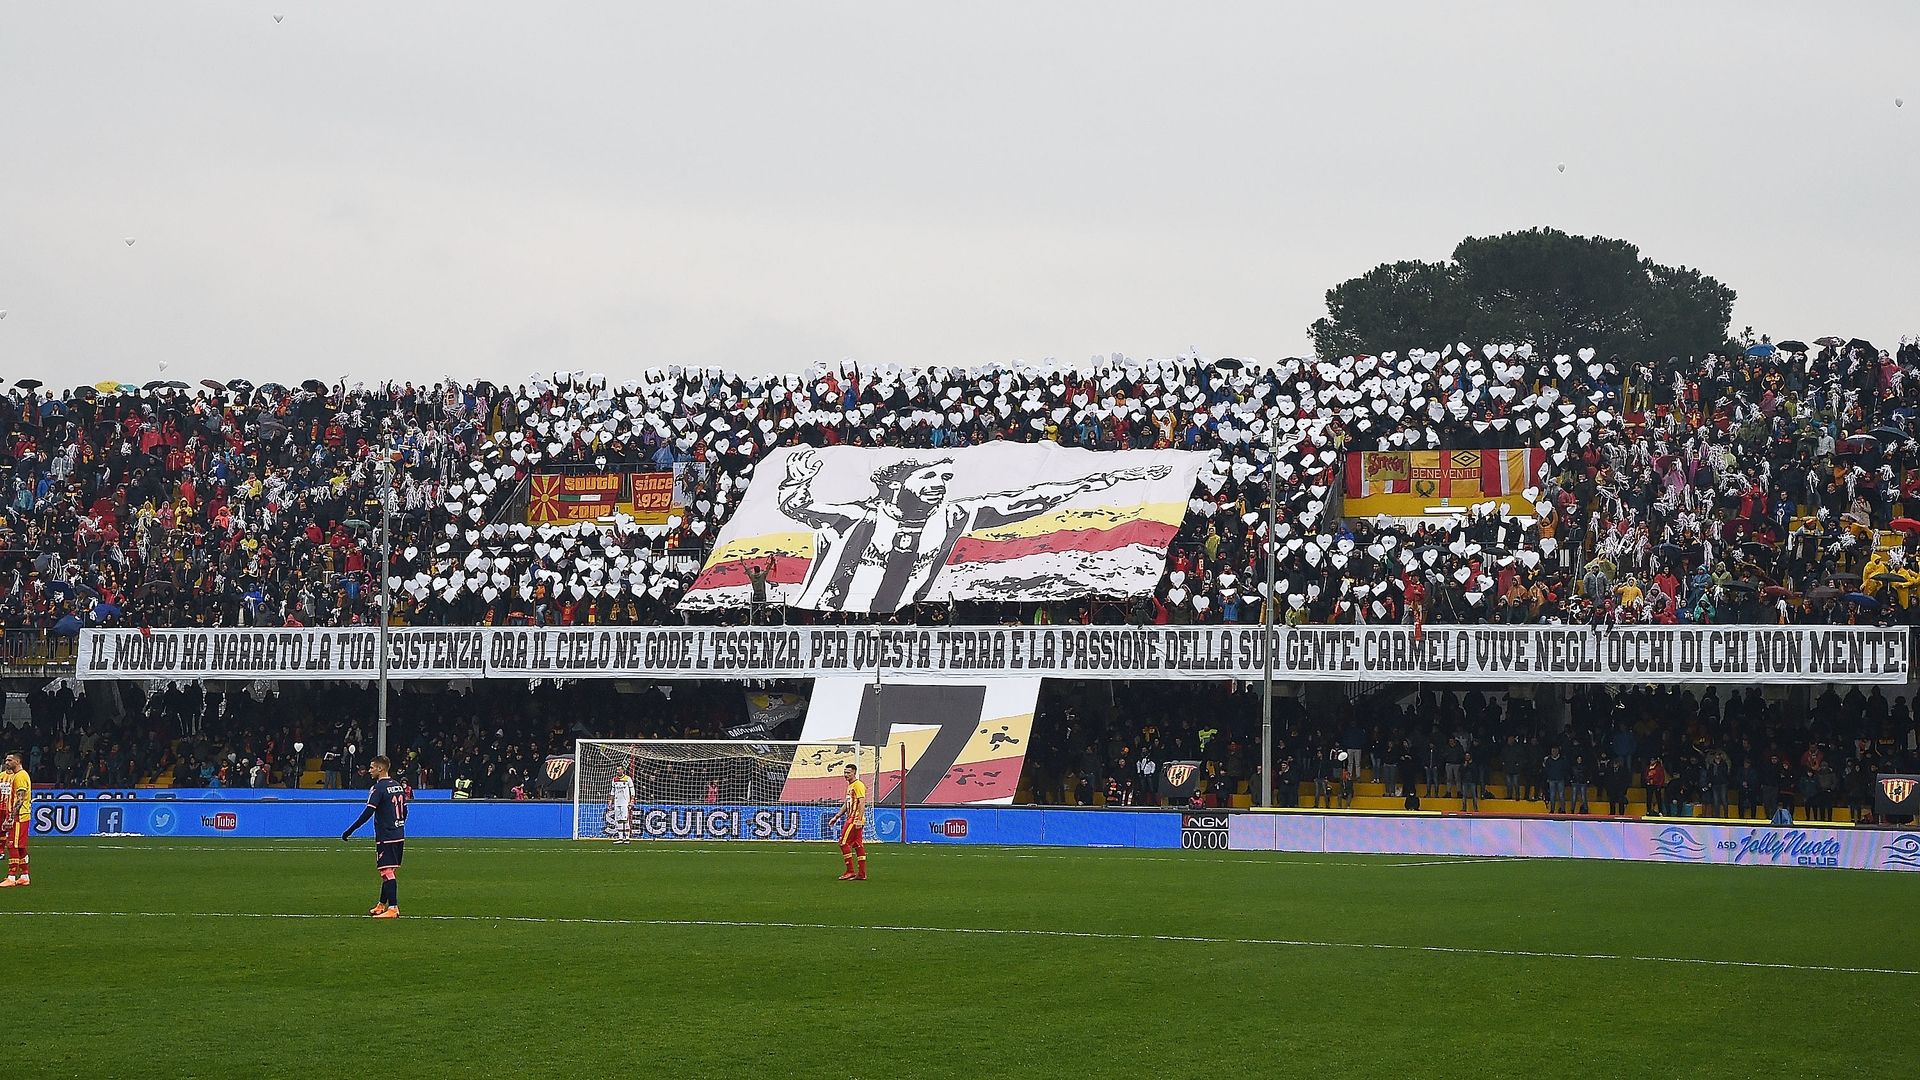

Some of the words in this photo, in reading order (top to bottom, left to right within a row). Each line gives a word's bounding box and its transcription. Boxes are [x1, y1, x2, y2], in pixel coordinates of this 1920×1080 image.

[1412, 468, 1479, 479] BENEVENTO
[89, 633, 108, 670] IL
[112, 633, 179, 670] MONDO
[182, 633, 207, 670] HA
[211, 633, 302, 670] NARRATO
[305, 633, 331, 670] LA
[337, 633, 375, 670] TUA
[490, 632, 528, 668] ORA
[533, 632, 551, 668] IL
[556, 632, 611, 668] CIELO
[613, 632, 641, 669] NE
[644, 632, 693, 669] GODE
[809, 631, 848, 669] PER
[853, 631, 930, 670] QUESTA
[937, 631, 1005, 669] TERRA
[1010, 631, 1024, 669] E
[1028, 631, 1055, 669] LA
[1061, 631, 1160, 669] PASSIONE
[1164, 631, 1233, 669] DELLA
[1364, 631, 1469, 671] CARMELO
[1475, 631, 1529, 671] VIVE
[1535, 631, 1601, 671] NEGLI
[1608, 631, 1674, 672] OCCHI
[1679, 631, 1702, 672] DI
[1709, 631, 1749, 672] CHI
[1755, 631, 1802, 672] NON
[1809, 631, 1906, 673] MENTE!
[35, 806, 78, 832] SU
[755, 811, 797, 836] SU
[1188, 817, 1228, 828] NGM
[1182, 831, 1228, 849] 00:00
[1717, 841, 1737, 849] ASD
[1797, 857, 1838, 866] CLUB
